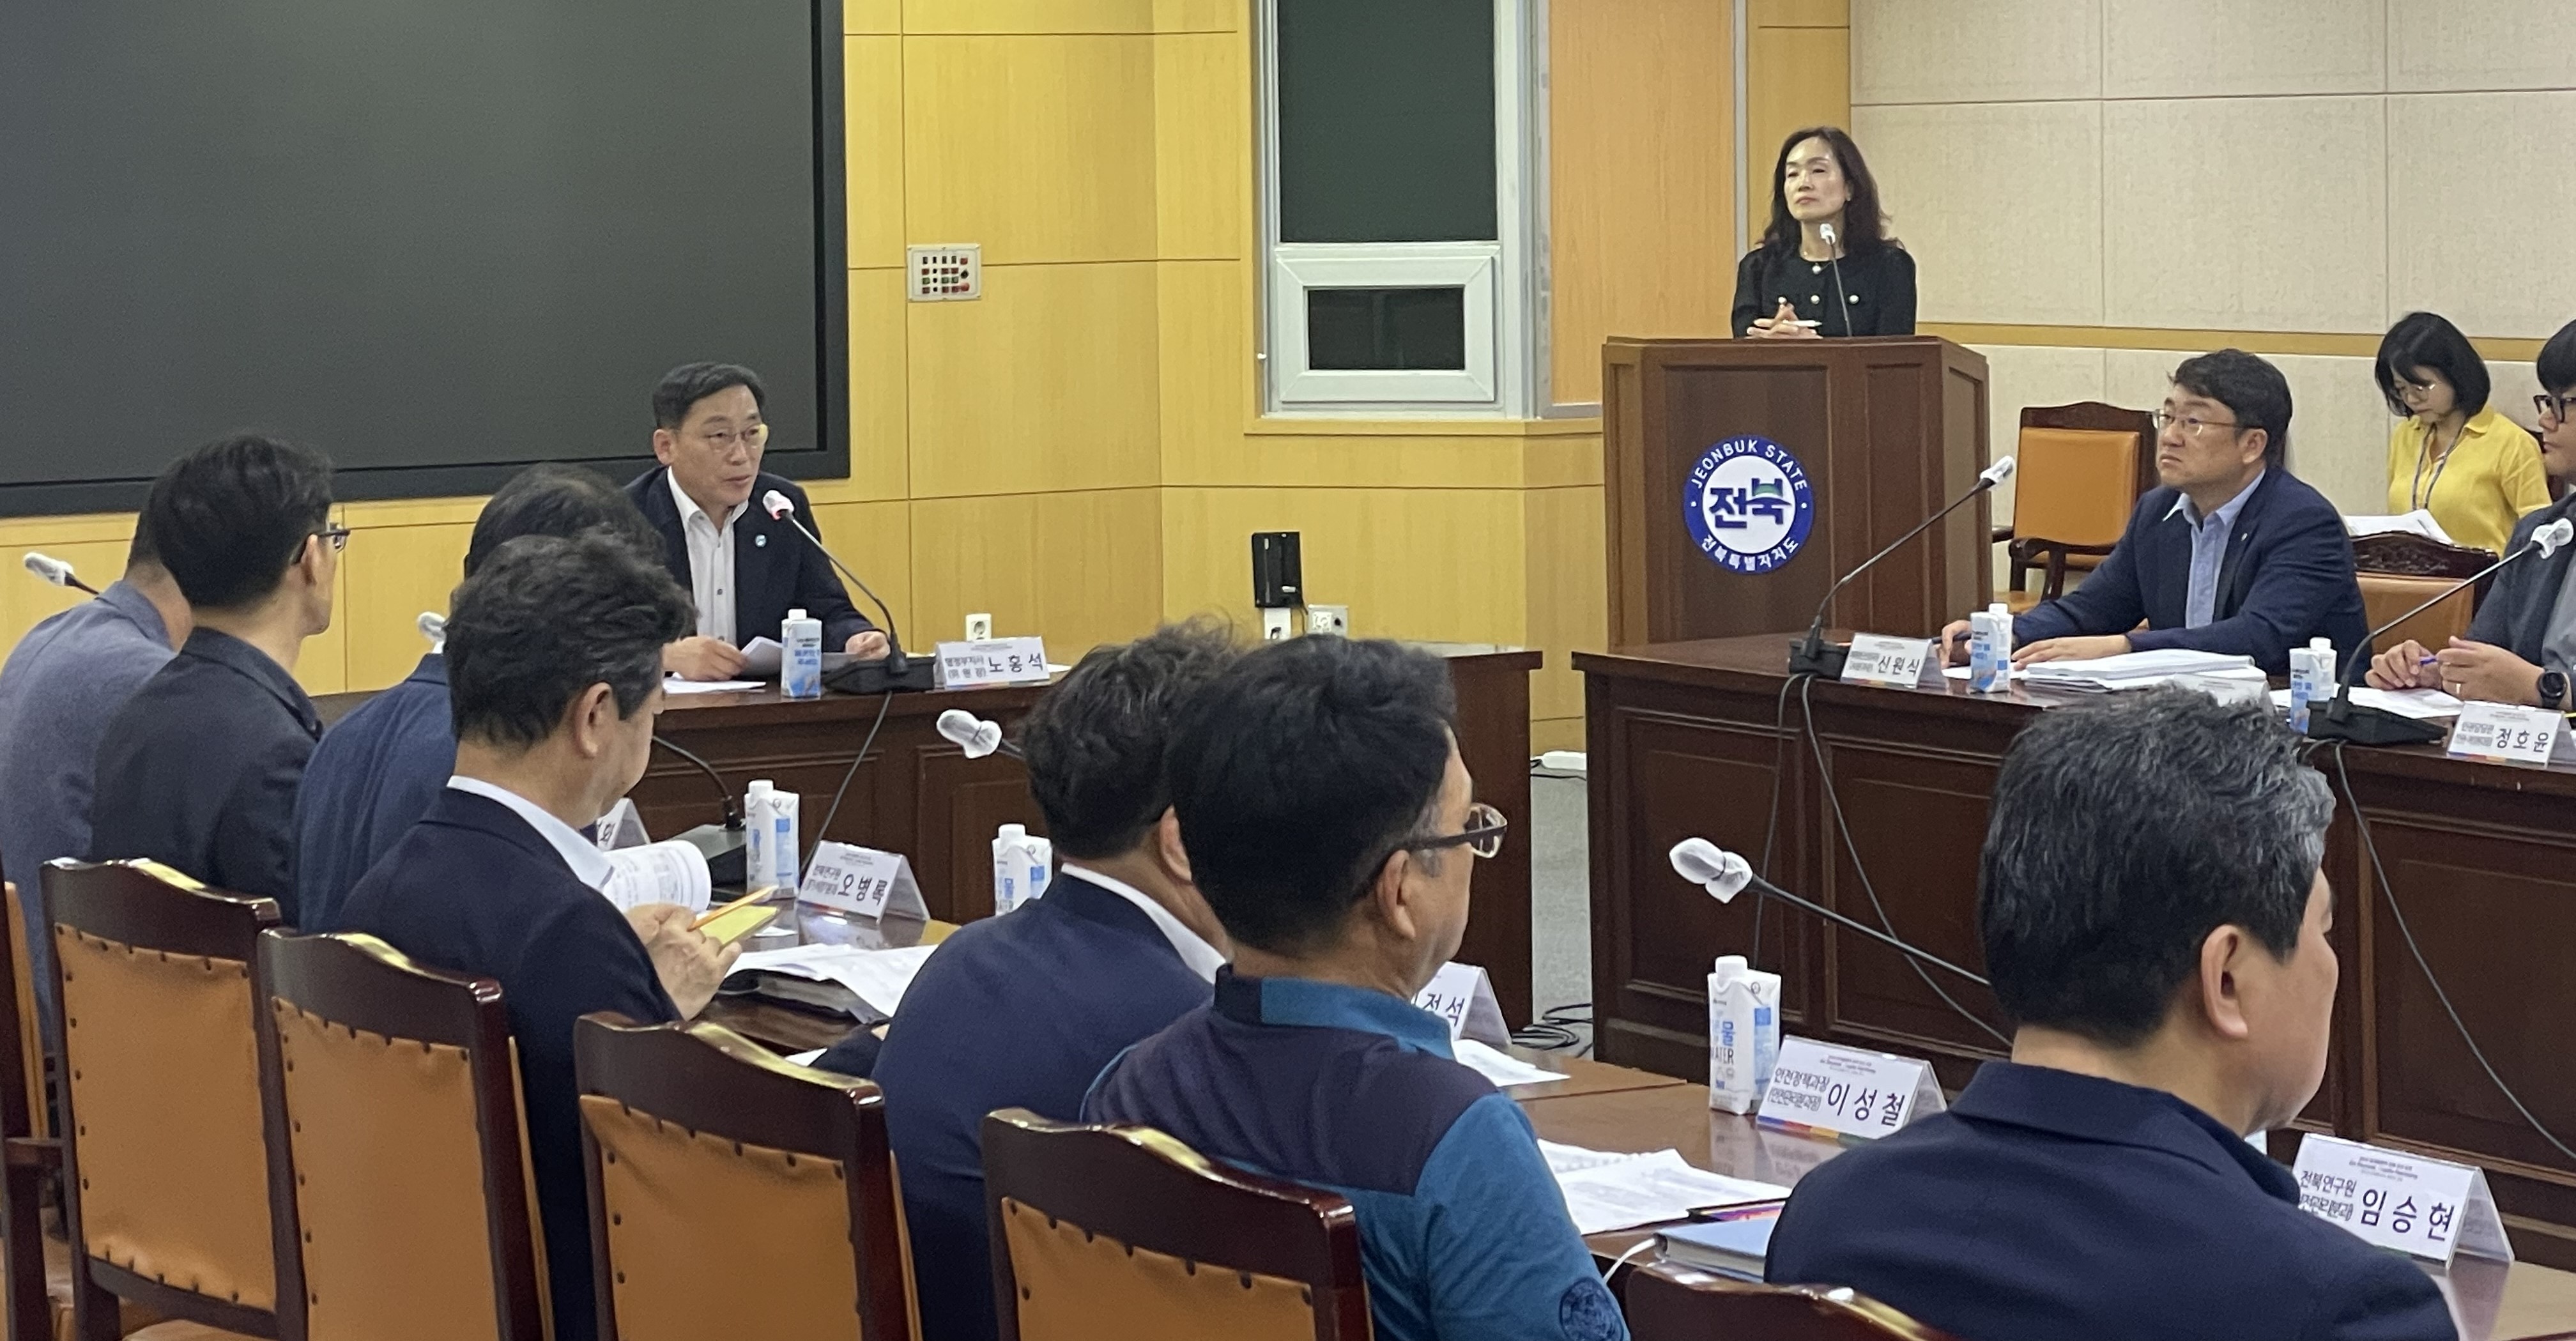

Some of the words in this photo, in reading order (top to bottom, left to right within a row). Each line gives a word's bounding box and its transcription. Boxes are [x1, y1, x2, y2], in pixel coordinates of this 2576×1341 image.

[1692, 439, 1758, 489] JEONBUK
[1765, 445, 1807, 491] STATE
[1709, 478, 1792, 529] 전북
[988, 652, 1043, 673] 노홍석
[1878, 655, 1920, 677] 신원식
[2496, 728, 2549, 753] 정호윤
[1722, 1020, 1736, 1047] 물
[1827, 1083, 1905, 1127] 이성철
[2300, 1170, 2357, 1198] 전북연구원
[2361, 1188, 2455, 1242] 임승현
